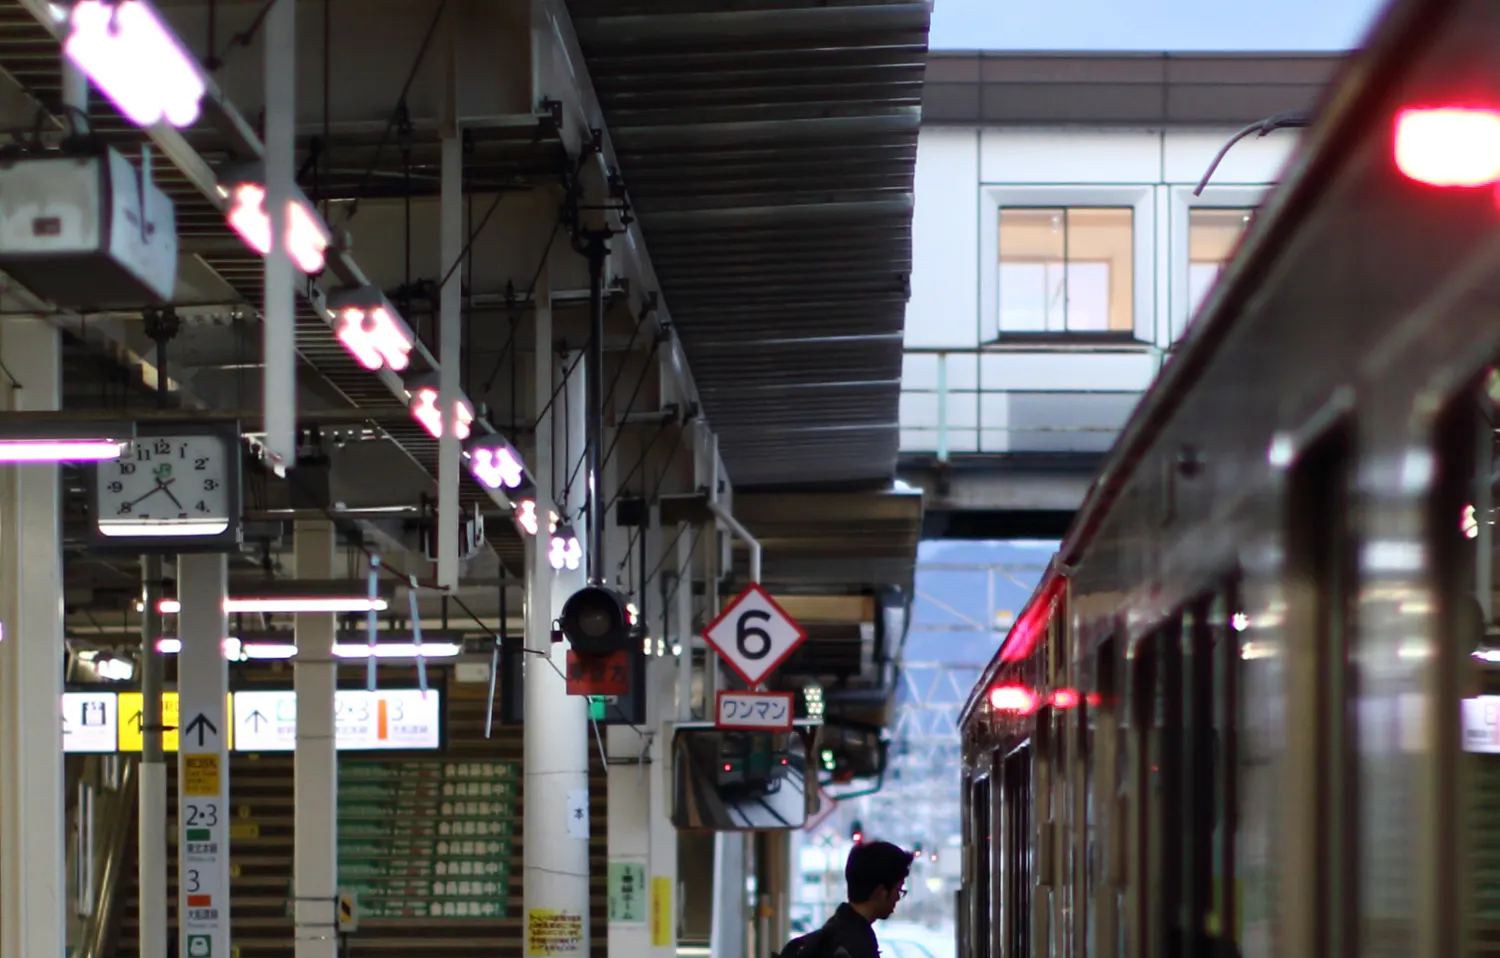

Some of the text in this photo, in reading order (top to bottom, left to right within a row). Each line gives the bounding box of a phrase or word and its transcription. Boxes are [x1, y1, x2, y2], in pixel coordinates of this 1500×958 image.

[154, 442, 171, 454] 12
[137, 449, 151, 461] 11
[120, 463, 136, 475] 10
[153, 463, 172, 477] JR
[195, 458, 206, 470] 2
[111, 481, 123, 493] 9
[203, 479, 215, 491] 3
[120, 502, 132, 514] 8
[195, 500, 206, 512] 4
[736, 609, 772, 660] 6
[391, 700, 404, 721] 3
[722, 700, 787, 720] ワンマン
[187, 869, 200, 892] 3
